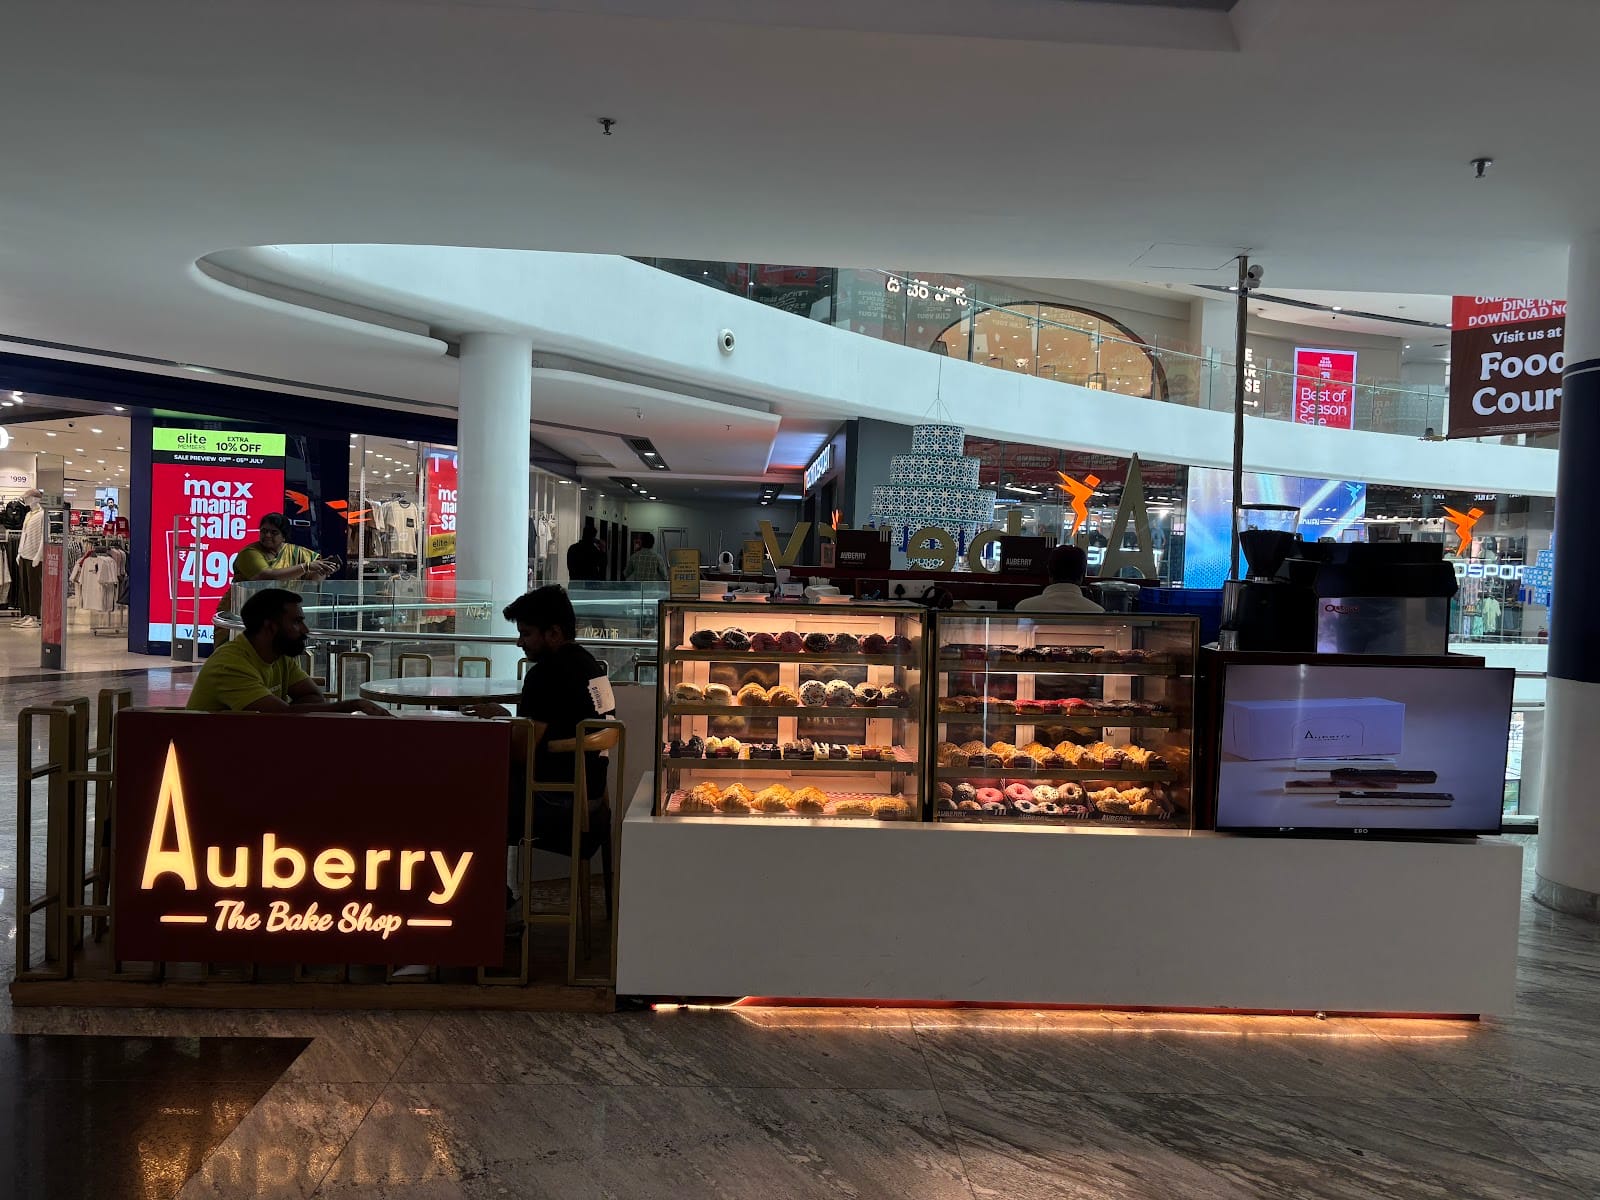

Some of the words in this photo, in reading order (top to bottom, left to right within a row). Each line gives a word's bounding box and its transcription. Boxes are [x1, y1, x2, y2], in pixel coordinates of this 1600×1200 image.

[1503, 298, 1534, 312] DINE
[1468, 307, 1549, 327] DOWNLOAD
[1492, 331, 1525, 345] Visit
[1528, 330, 1544, 341] us
[1547, 327, 1562, 338] at
[1301, 387, 1330, 402] Best
[1332, 389, 1347, 402] of
[1472, 387, 1563, 416] Cour
[1300, 400, 1347, 416] Season
[1299, 414, 1327, 426] Sae
[177, 433, 207, 444] elite
[216, 442, 238, 452] 10%
[239, 443, 262, 453] OFF
[183, 479, 254, 499] max
[189, 498, 247, 516] mania
[190, 512, 246, 540] sale
[178, 550, 239, 589] ₹49
[140, 738, 473, 905] Auberry
[214, 900, 261, 932] The
[265, 900, 334, 933] Bake
[337, 901, 402, 940] Shop
